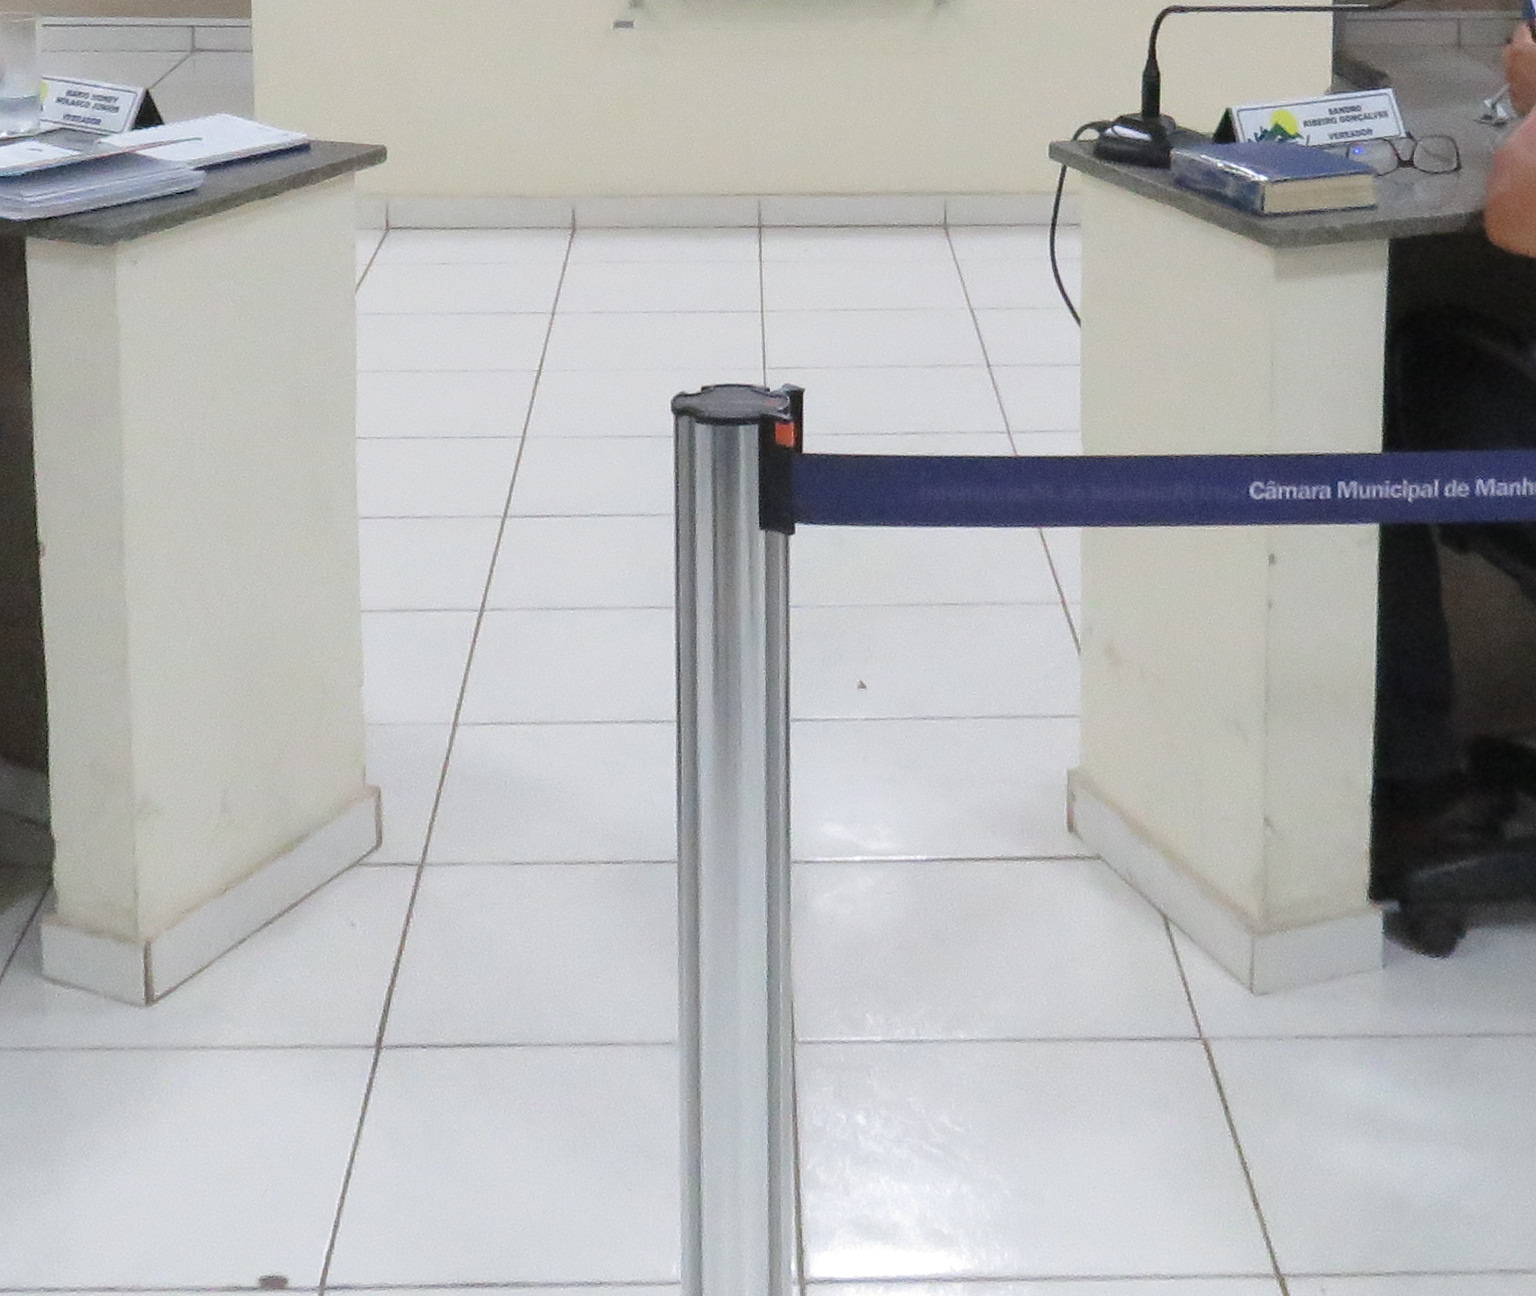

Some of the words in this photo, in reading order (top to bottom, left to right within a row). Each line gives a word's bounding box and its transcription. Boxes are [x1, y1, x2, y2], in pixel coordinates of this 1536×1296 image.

[1328, 105, 1363, 116] SANDRO
[1328, 127, 1374, 140] VEREADOR
[1248, 478, 1332, 501] Câmara
[1337, 478, 1439, 503] Municipal
[1443, 477, 1470, 498] de
